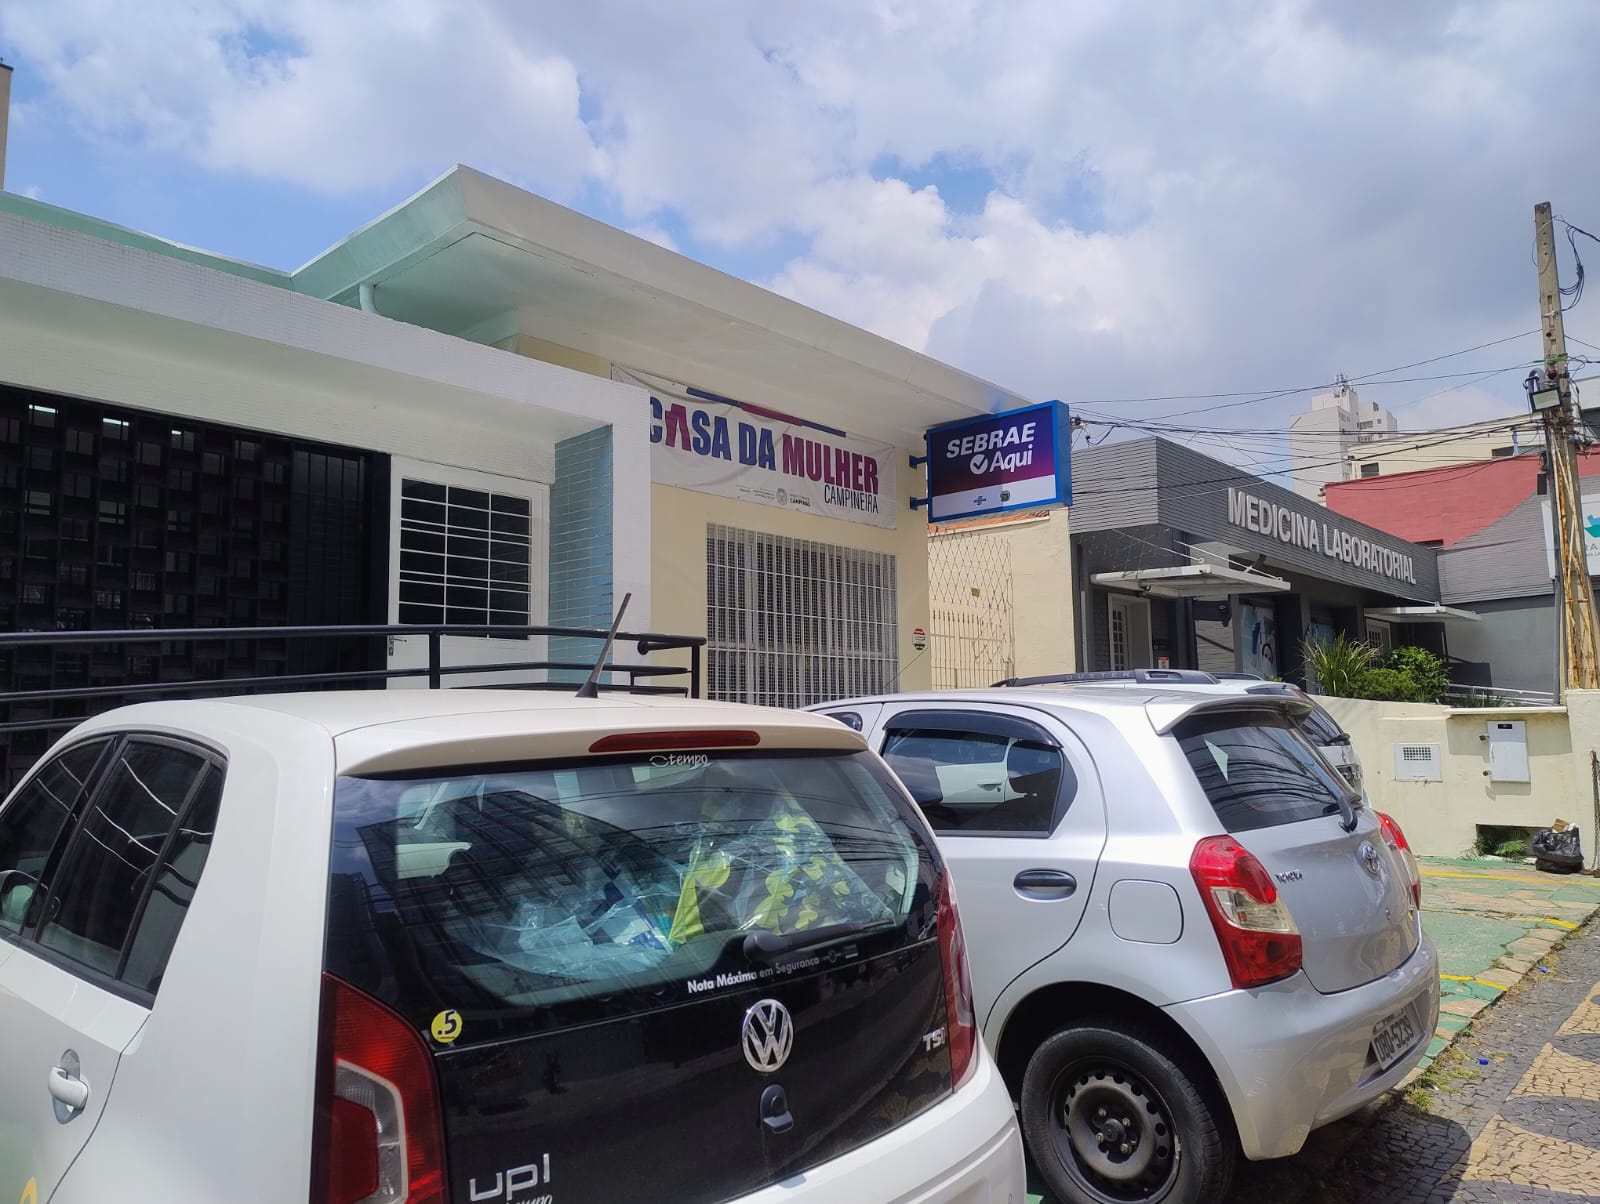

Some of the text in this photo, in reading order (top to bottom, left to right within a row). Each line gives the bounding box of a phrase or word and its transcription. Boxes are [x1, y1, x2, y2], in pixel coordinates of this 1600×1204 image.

[650, 396, 878, 495] CASA DA MULHER
[946, 422, 1036, 459] SEBRAE
[989, 444, 1033, 473] Aqui
[824, 484, 878, 514] CAMPINEIRA
[1228, 487, 1416, 585] MEDICINA LABORATORIAL
[1065, 671, 1130, 681] DUSTER
[687, 979, 715, 994] Nota
[716, 971, 757, 987] Máxima
[759, 968, 774, 979] em
